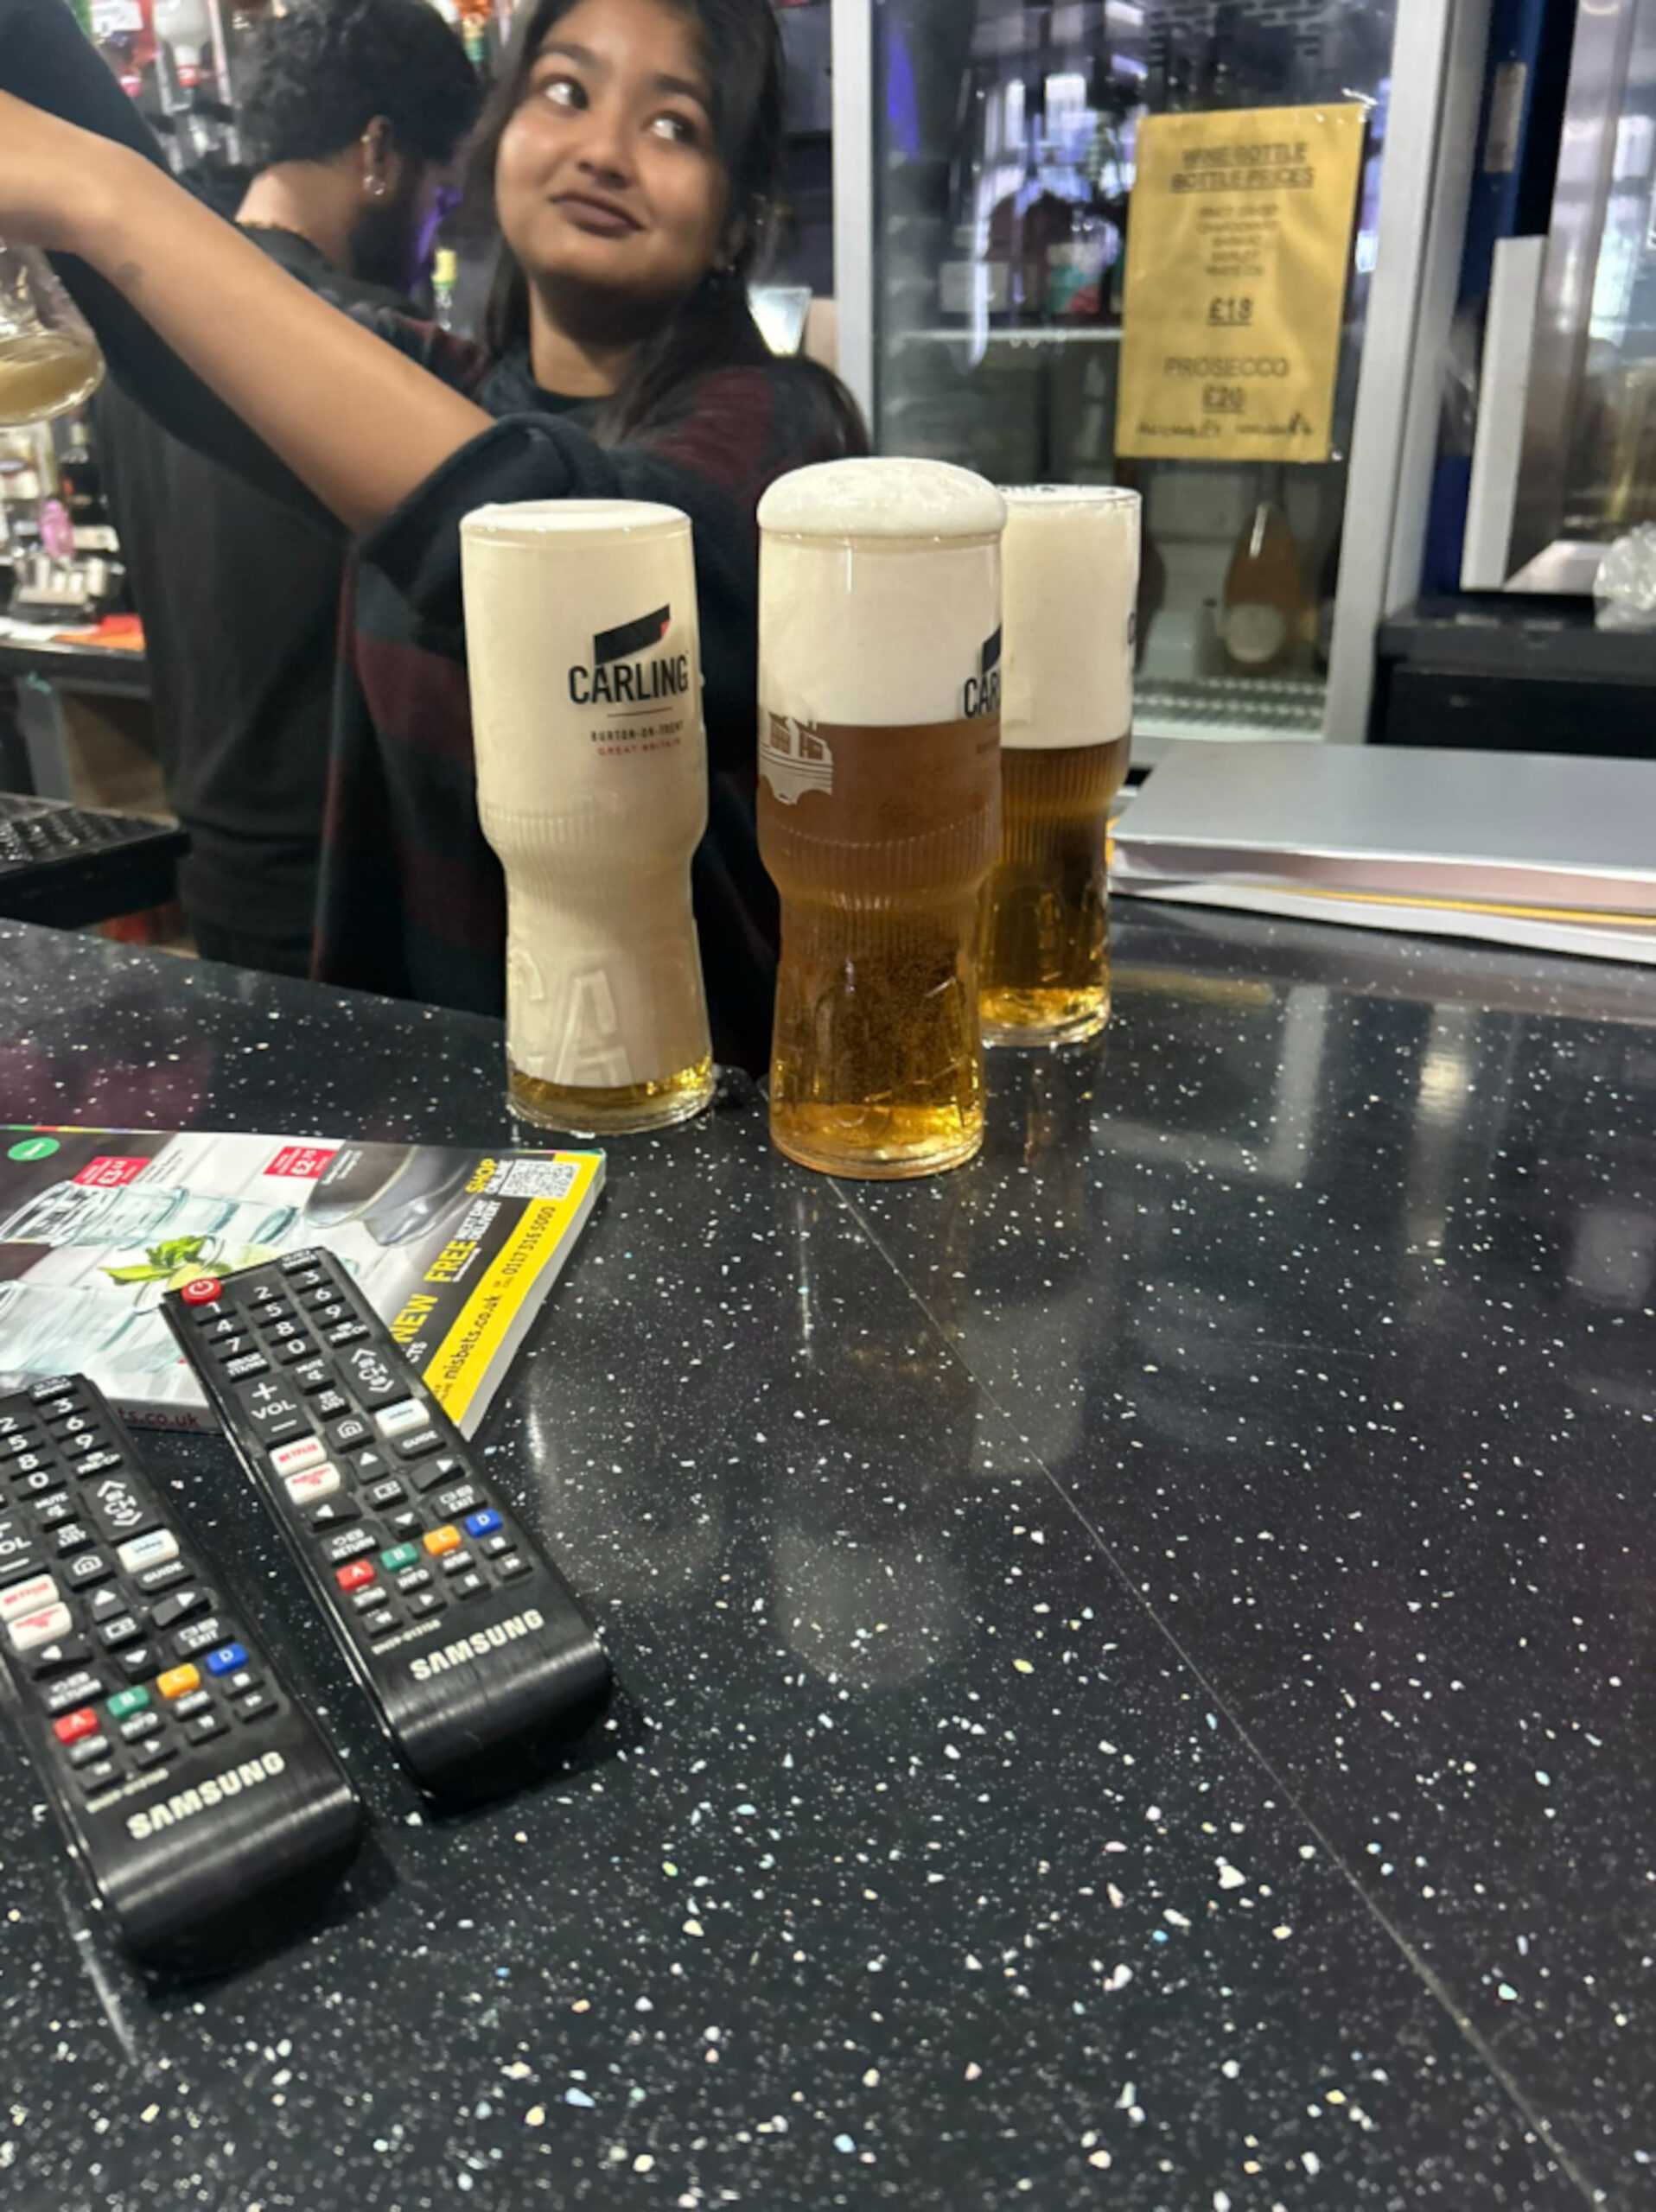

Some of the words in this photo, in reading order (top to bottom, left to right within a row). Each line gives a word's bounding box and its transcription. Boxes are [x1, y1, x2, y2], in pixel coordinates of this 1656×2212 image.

[1163, 356, 1290, 378] PROSECCO
[568, 654, 689, 704] CARLING
[597, 744, 637, 757] GREAT
[464, 1158, 498, 1194] SHOP
[424, 1240, 478, 1283] FREE
[303, 1271, 320, 1285] 3
[254, 1286, 273, 1300] 2
[315, 1288, 333, 1301] 6
[265, 1302, 283, 1318] 5
[325, 1304, 342, 1319] 9
[217, 1319, 234, 1333] 4
[389, 1294, 439, 1344] NEW
[276, 1320, 296, 1337] 8
[443, 1293, 502, 1380] nisbets.co.uk
[226, 1337, 241, 1352] 7
[286, 1339, 306, 1355] 0
[358, 1363, 389, 1382] CH
[53, 1397, 73, 1414] 3
[252, 1399, 297, 1420] VOL
[67, 1415, 86, 1431] 6
[8, 1434, 29, 1452] 5
[75, 1433, 94, 1450] 9
[402, 1430, 438, 1449] GUIDE
[17, 1453, 39, 1470] 8
[28, 1471, 49, 1489] 0
[143, 1560, 185, 1583] GUIDE
[409, 1608, 546, 1681] SAMSUNG
[126, 1750, 286, 1840] SAMSUNG
